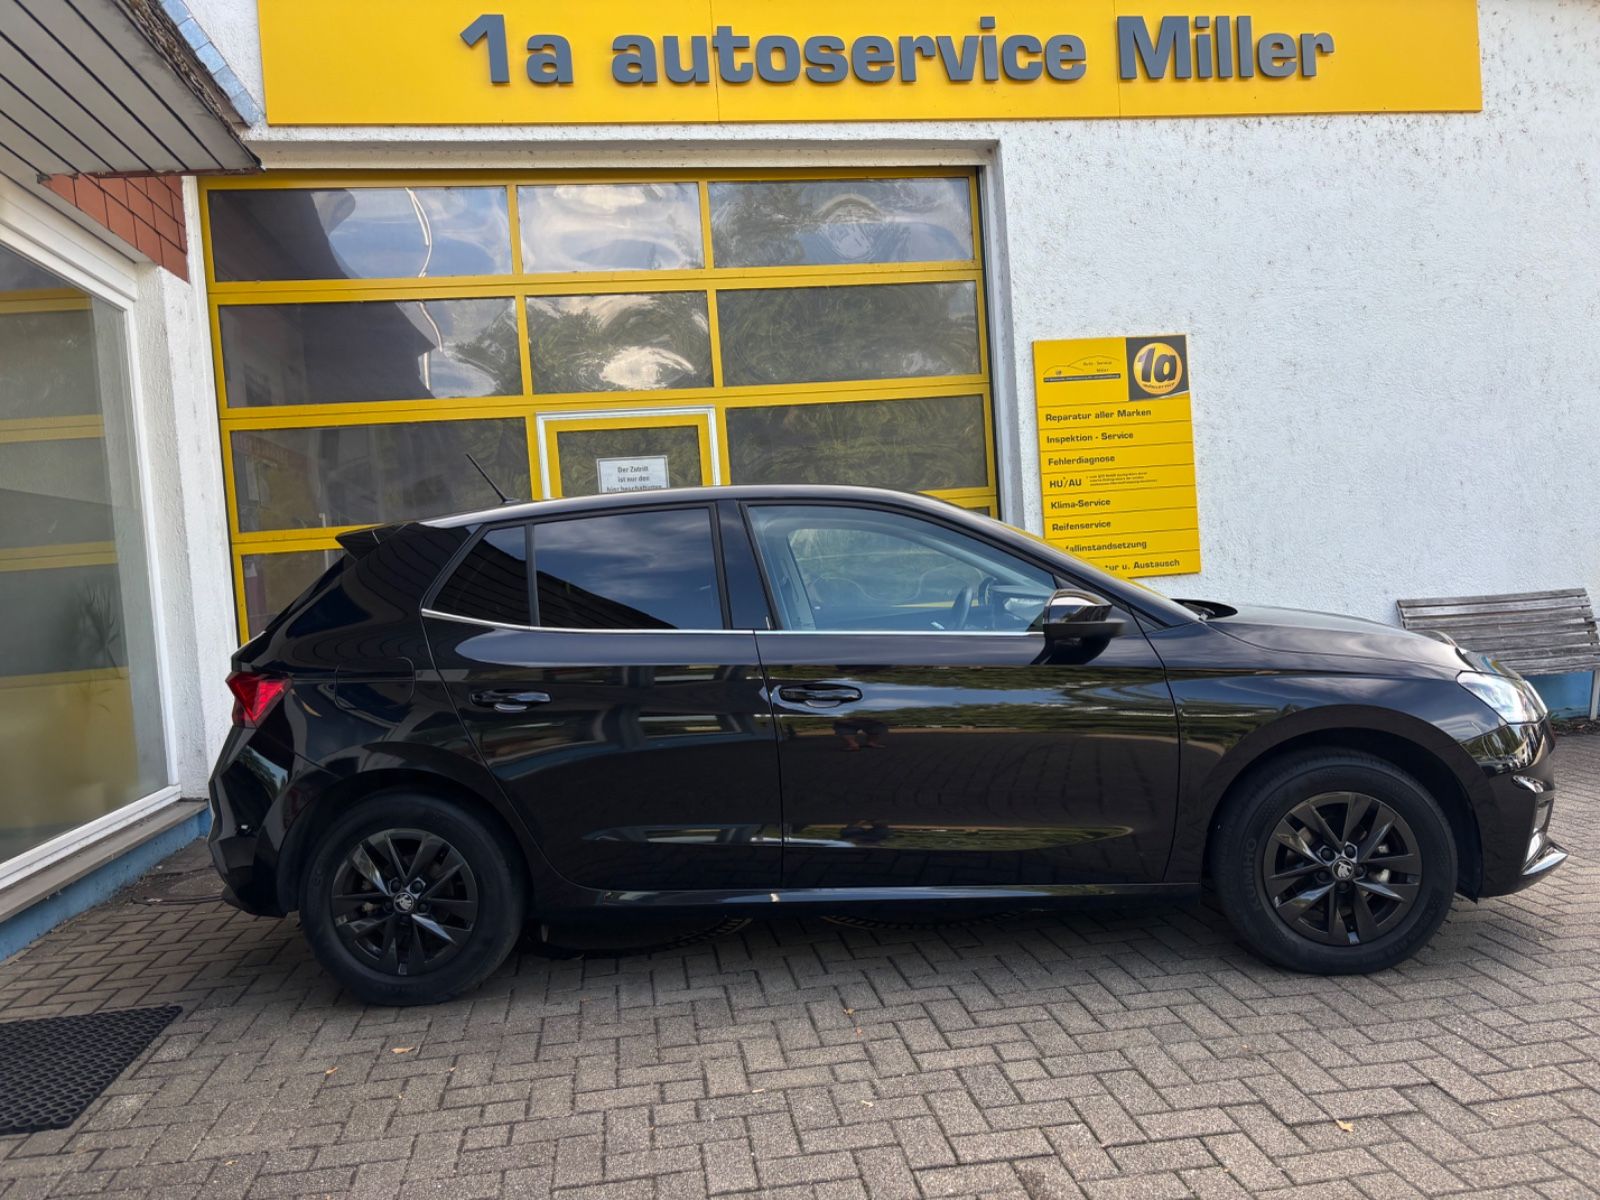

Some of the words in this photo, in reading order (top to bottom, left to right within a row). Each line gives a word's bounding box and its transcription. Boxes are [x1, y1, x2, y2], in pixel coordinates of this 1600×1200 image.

[459, 14, 574, 84] 1a
[611, 16, 1087, 84] autoservice
[1117, 15, 1335, 80] Miller
[1138, 347, 1177, 383] 1a
[1045, 413, 1091, 423] Reparatur
[1095, 411, 1114, 419] aller
[1117, 409, 1152, 418] Marken
[1046, 434, 1093, 444] Inspektion
[1101, 432, 1134, 440] Service
[1048, 455, 1116, 466] Fehlerdiagnose
[1051, 499, 1111, 510] Klima-Service
[1052, 520, 1112, 532] Reifenservice
[1133, 559, 1180, 569] Austausch
